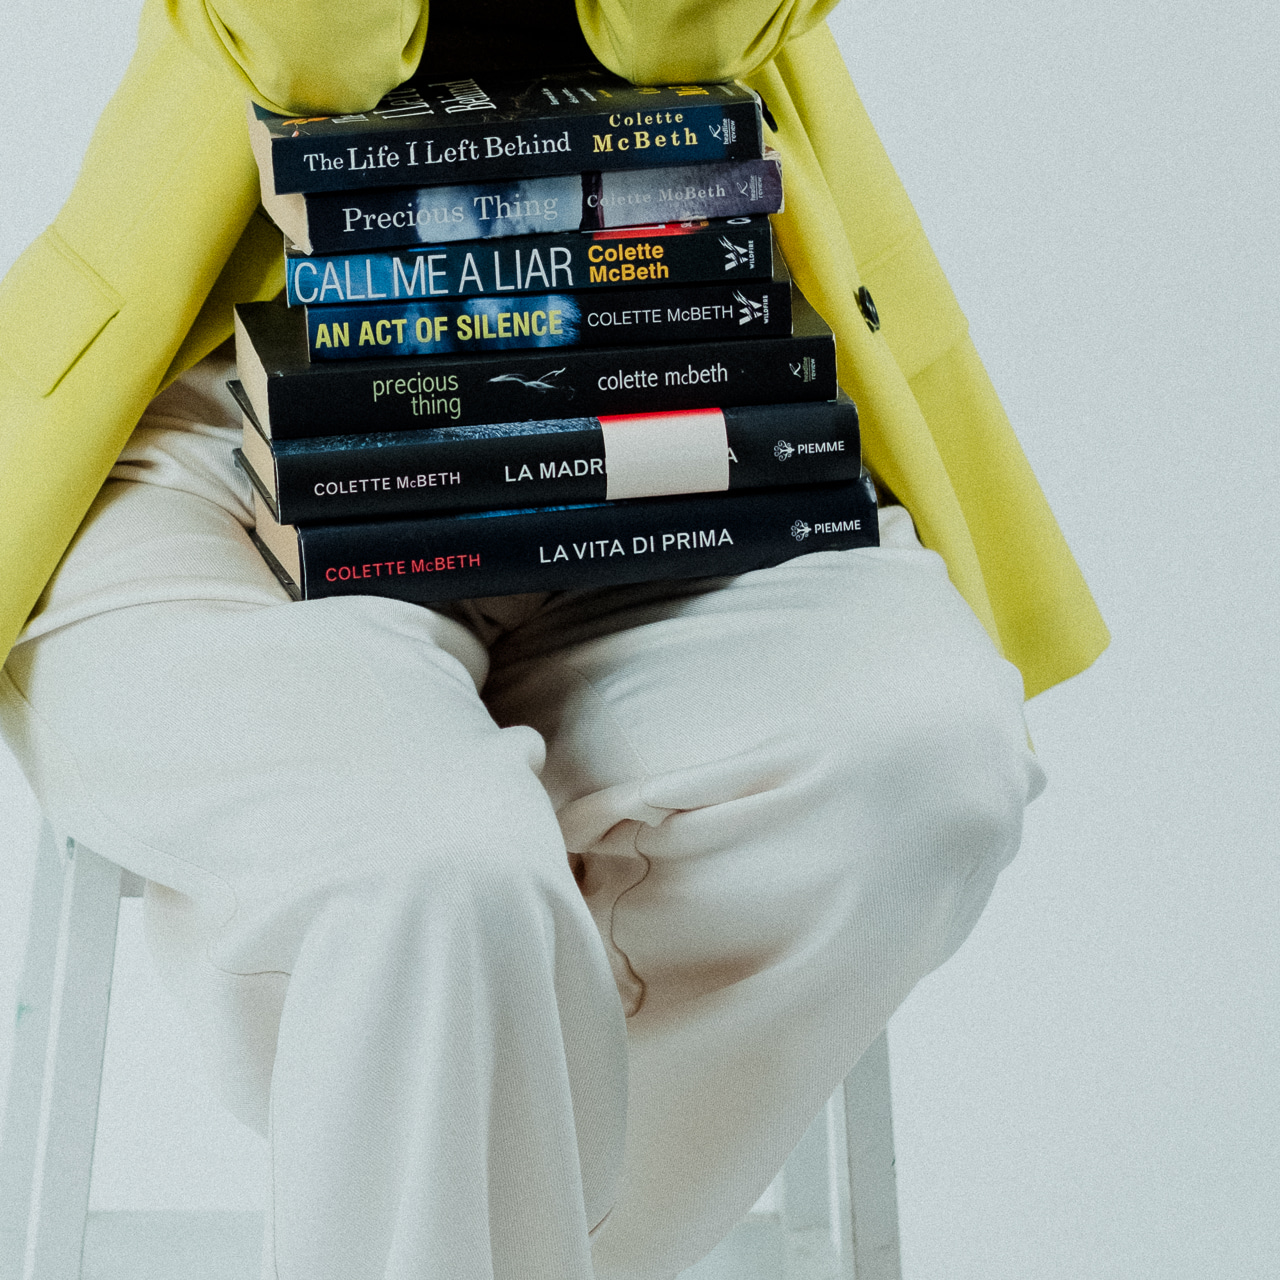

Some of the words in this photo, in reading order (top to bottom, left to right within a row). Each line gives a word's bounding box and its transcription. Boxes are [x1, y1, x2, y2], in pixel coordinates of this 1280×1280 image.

[428, 78, 497, 114] Behind
[609, 112, 684, 128] Colette
[304, 154, 344, 172] The
[347, 145, 400, 171] Life
[406, 142, 419, 166] I
[424, 139, 479, 164] Left
[484, 131, 571, 158] Behind
[593, 127, 699, 153] McBeth
[587, 192, 652, 208] Colette
[659, 184, 726, 203] McBeth
[343, 202, 464, 232] Precious
[474, 195, 558, 220] Thing
[588, 242, 664, 263] Colette
[294, 259, 386, 303] CALL
[392, 254, 448, 297] ME
[459, 252, 483, 293] A
[494, 247, 574, 291] LIAR
[589, 262, 669, 283] McBeth
[315, 322, 350, 349] AN
[358, 319, 407, 347] ACT
[416, 316, 448, 343] OF
[457, 309, 564, 341] SILENCE
[587, 309, 662, 327] COLETTE
[667, 305, 733, 322] McBETH
[373, 372, 459, 402] precious
[598, 370, 658, 391] colette
[665, 362, 728, 387] mcbeth
[410, 394, 461, 420] thing
[797, 440, 845, 455] PIEMME
[505, 464, 533, 482] LA
[539, 457, 607, 480] MADR
[314, 478, 391, 496] COLETTE
[396, 471, 461, 490] McBETH
[814, 519, 862, 534] PIEMME
[539, 545, 569, 564] LA
[573, 538, 625, 559] VITA
[632, 535, 655, 554] DI
[662, 528, 734, 552] PRIMA
[325, 560, 406, 582] COLETTE
[411, 553, 481, 573] McBETH
